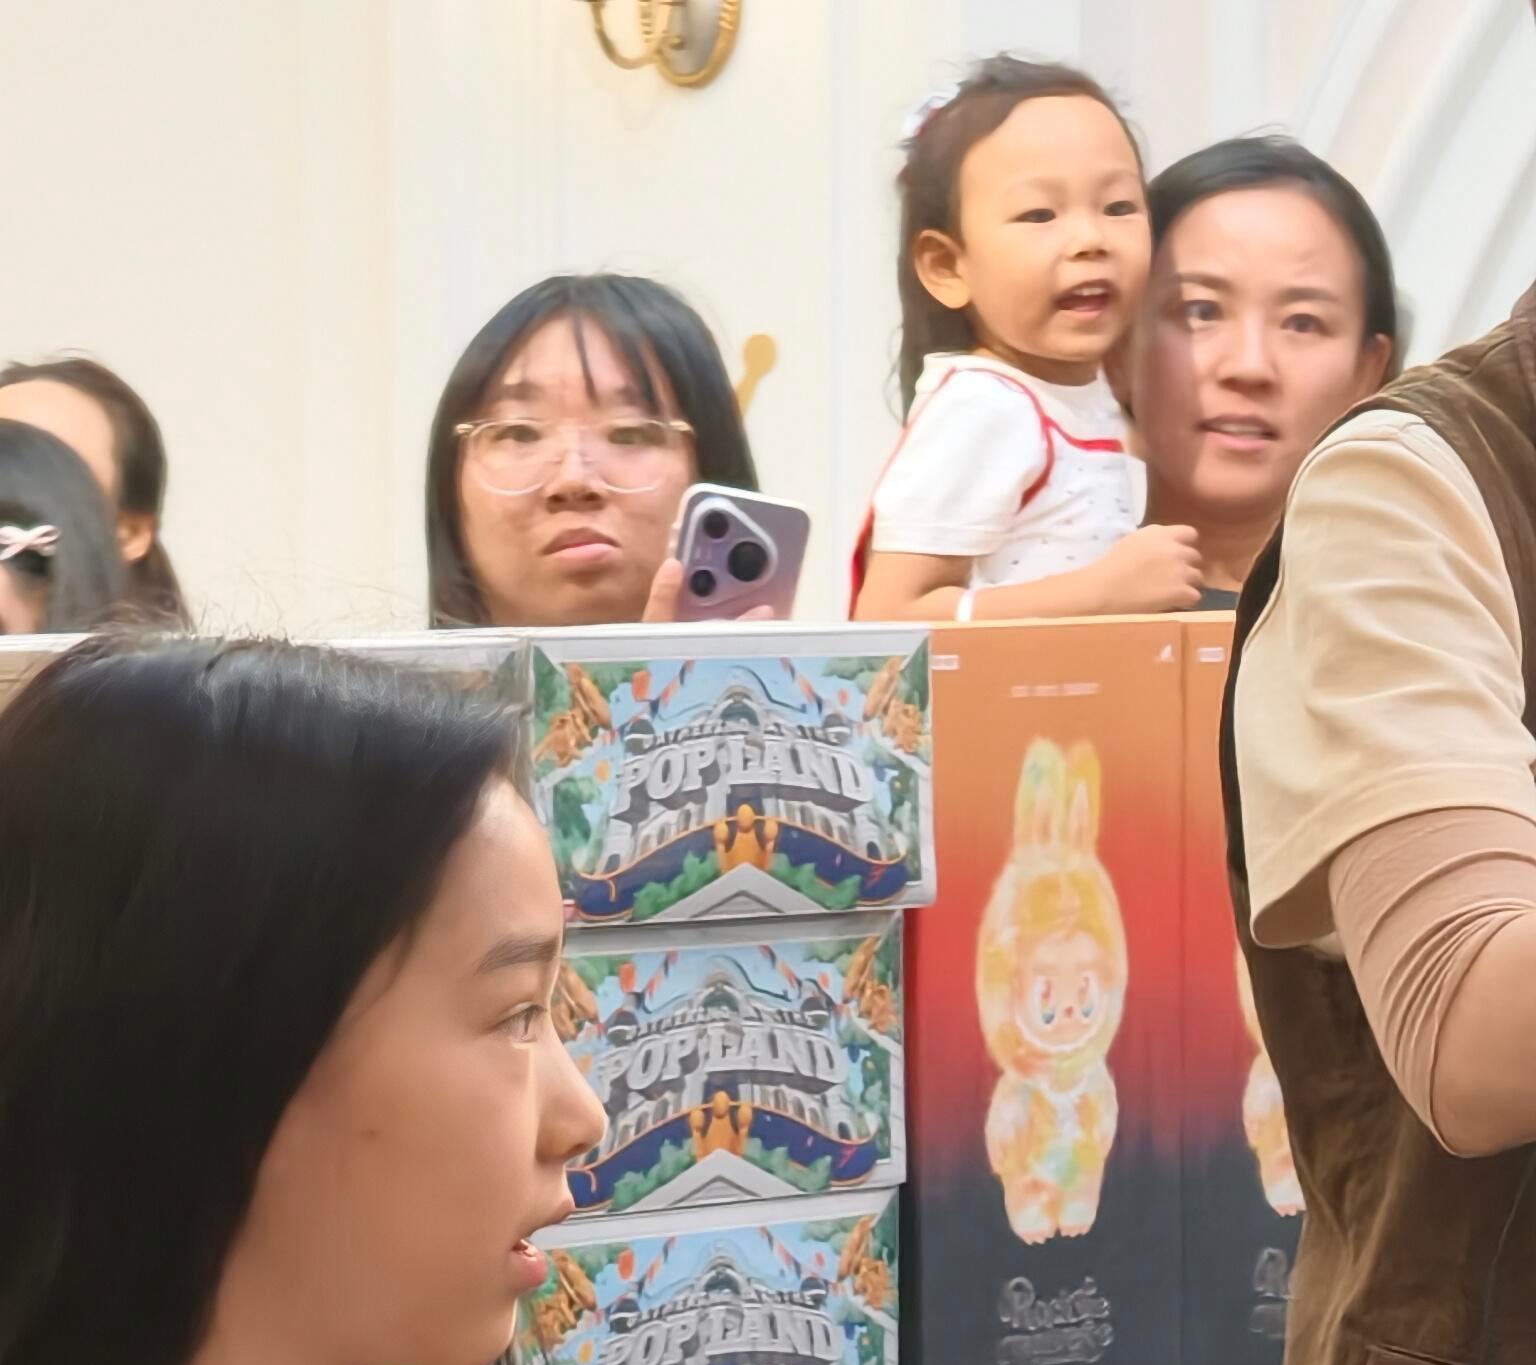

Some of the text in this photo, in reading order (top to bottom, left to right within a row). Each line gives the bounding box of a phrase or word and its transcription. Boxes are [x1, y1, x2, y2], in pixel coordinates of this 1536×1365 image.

[610, 735, 874, 818] POP LAND
[596, 1034, 701, 1106] POP
[706, 1021, 848, 1086] LAND
[705, 1303, 842, 1361] LAND
